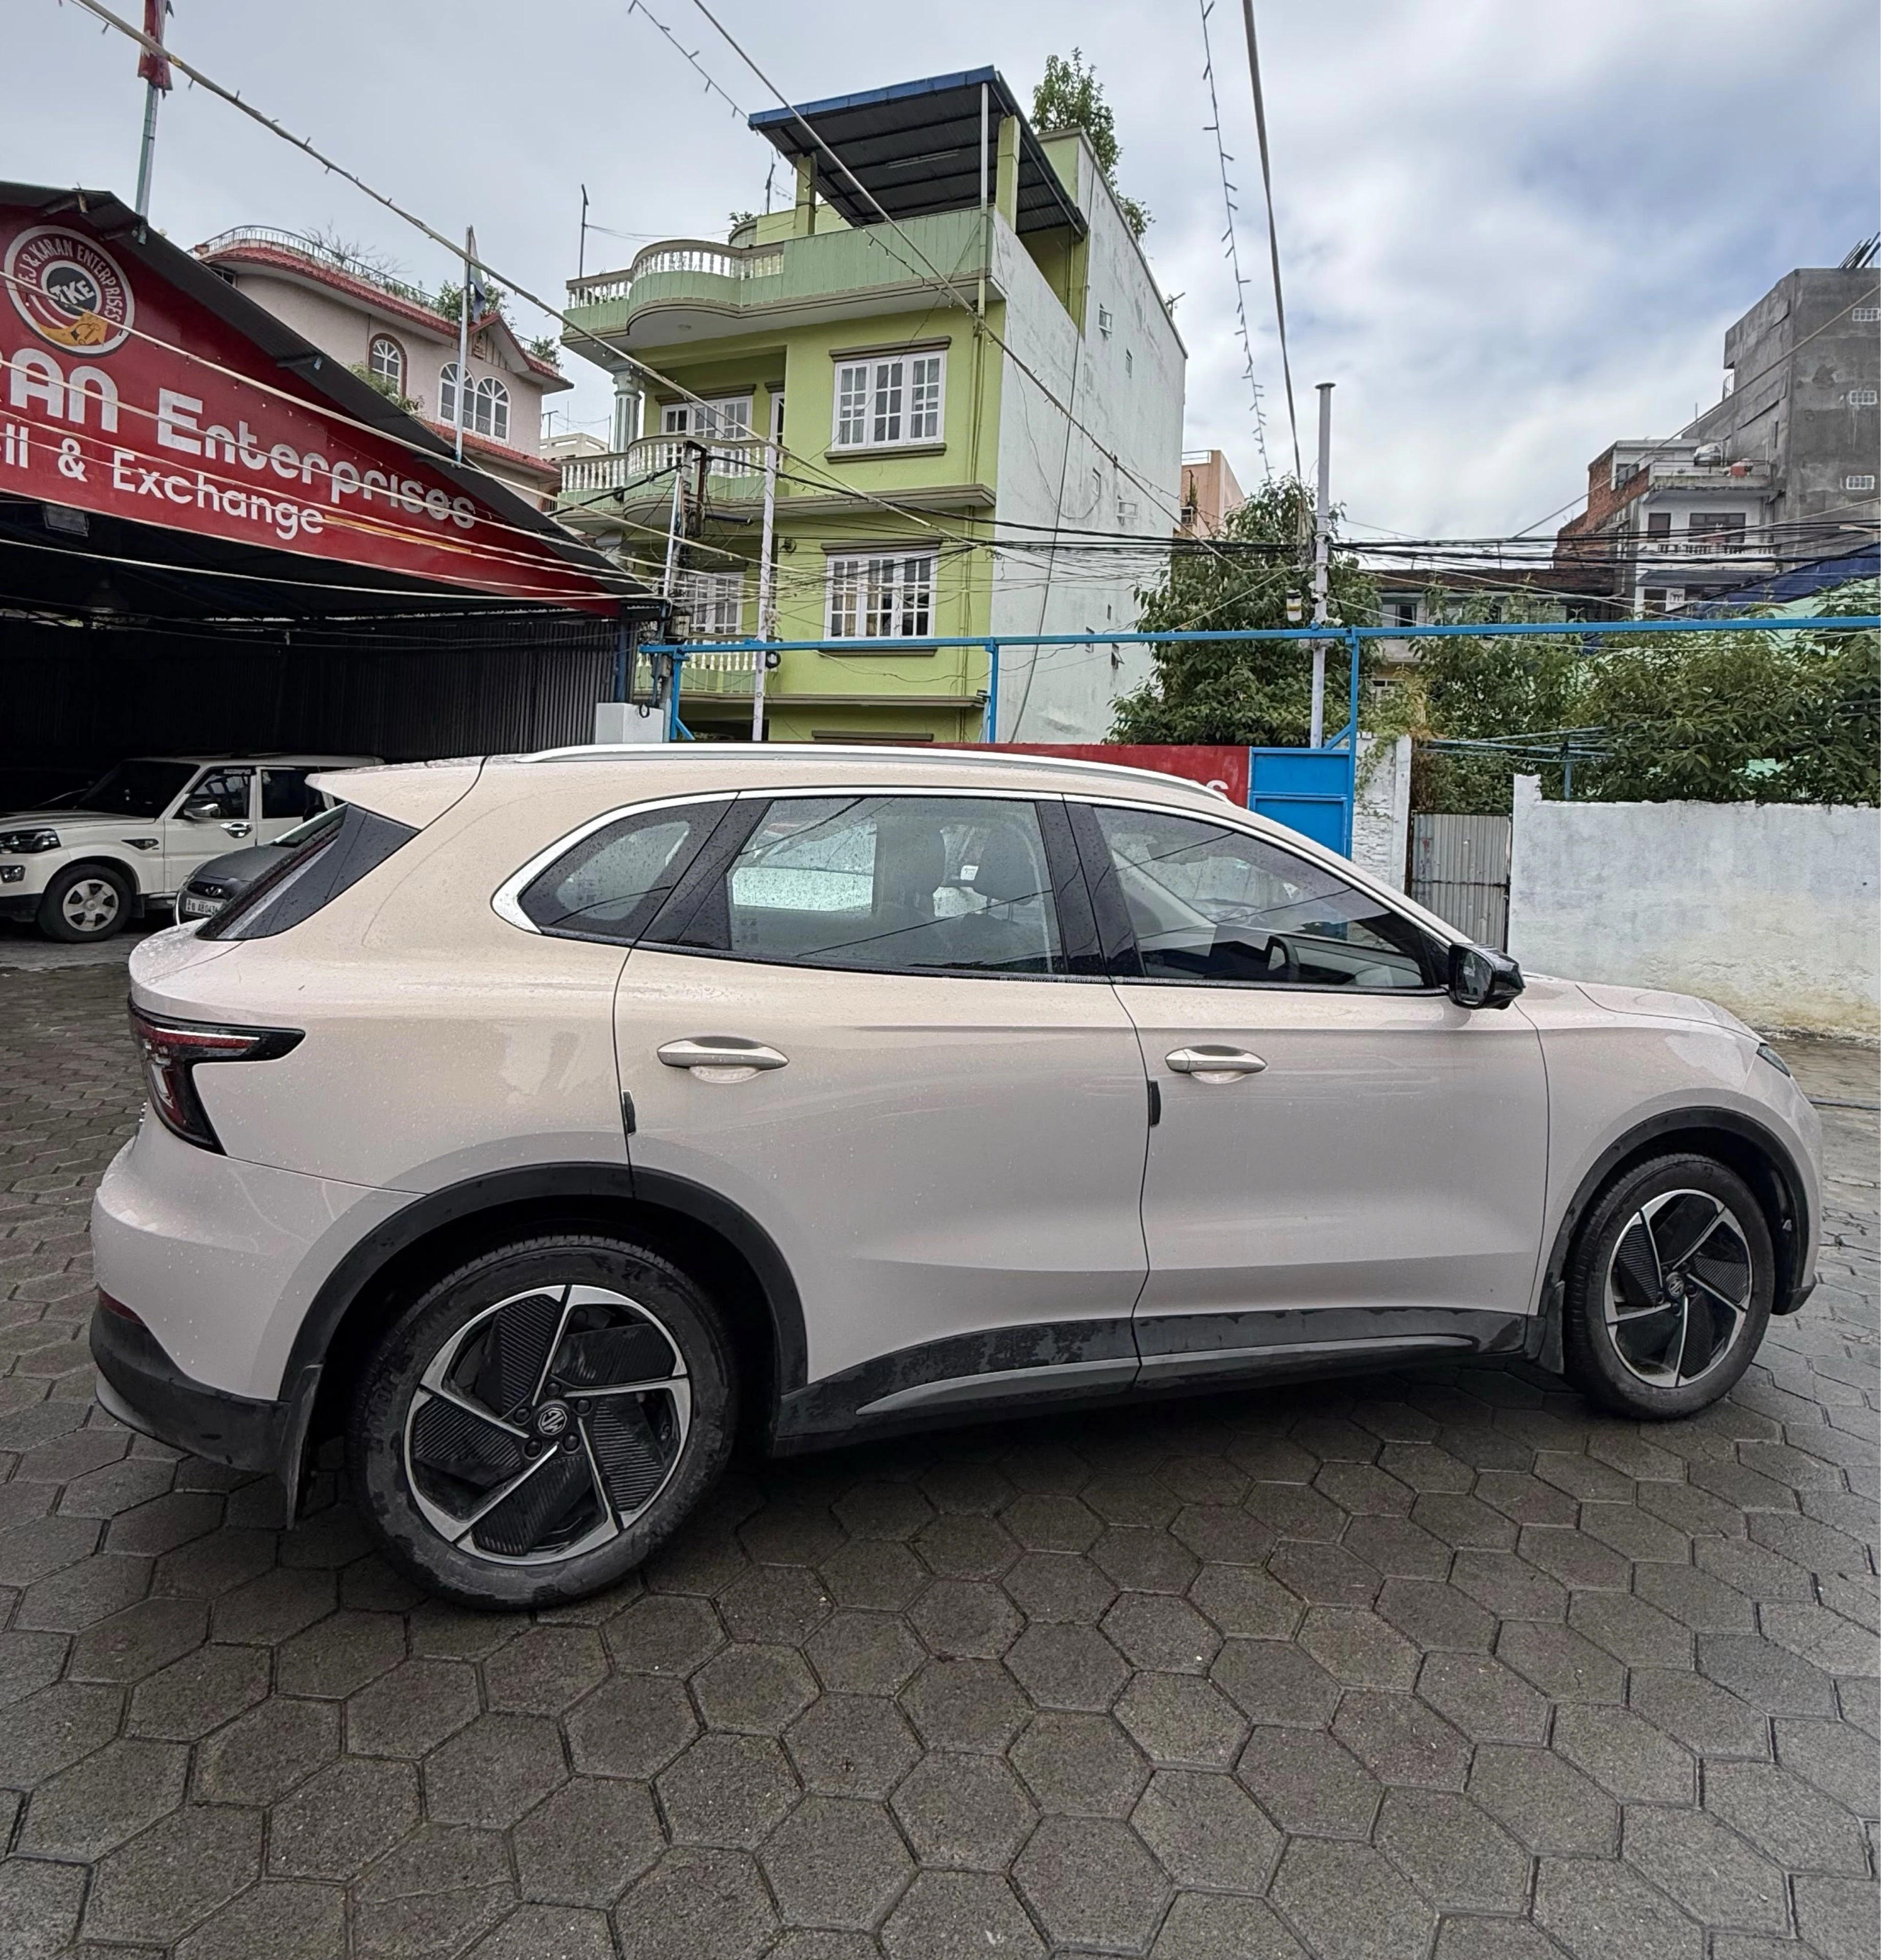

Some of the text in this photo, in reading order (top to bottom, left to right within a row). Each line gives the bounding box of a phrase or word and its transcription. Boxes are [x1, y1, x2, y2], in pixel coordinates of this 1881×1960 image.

[22, 253, 41, 268] &
[29, 238, 74, 261] KARAN
[77, 244, 123, 322] ENTERPRISES
[58, 437, 88, 482] &
[113, 450, 324, 540] Exchange
[157, 387, 476, 529] Enterprises
